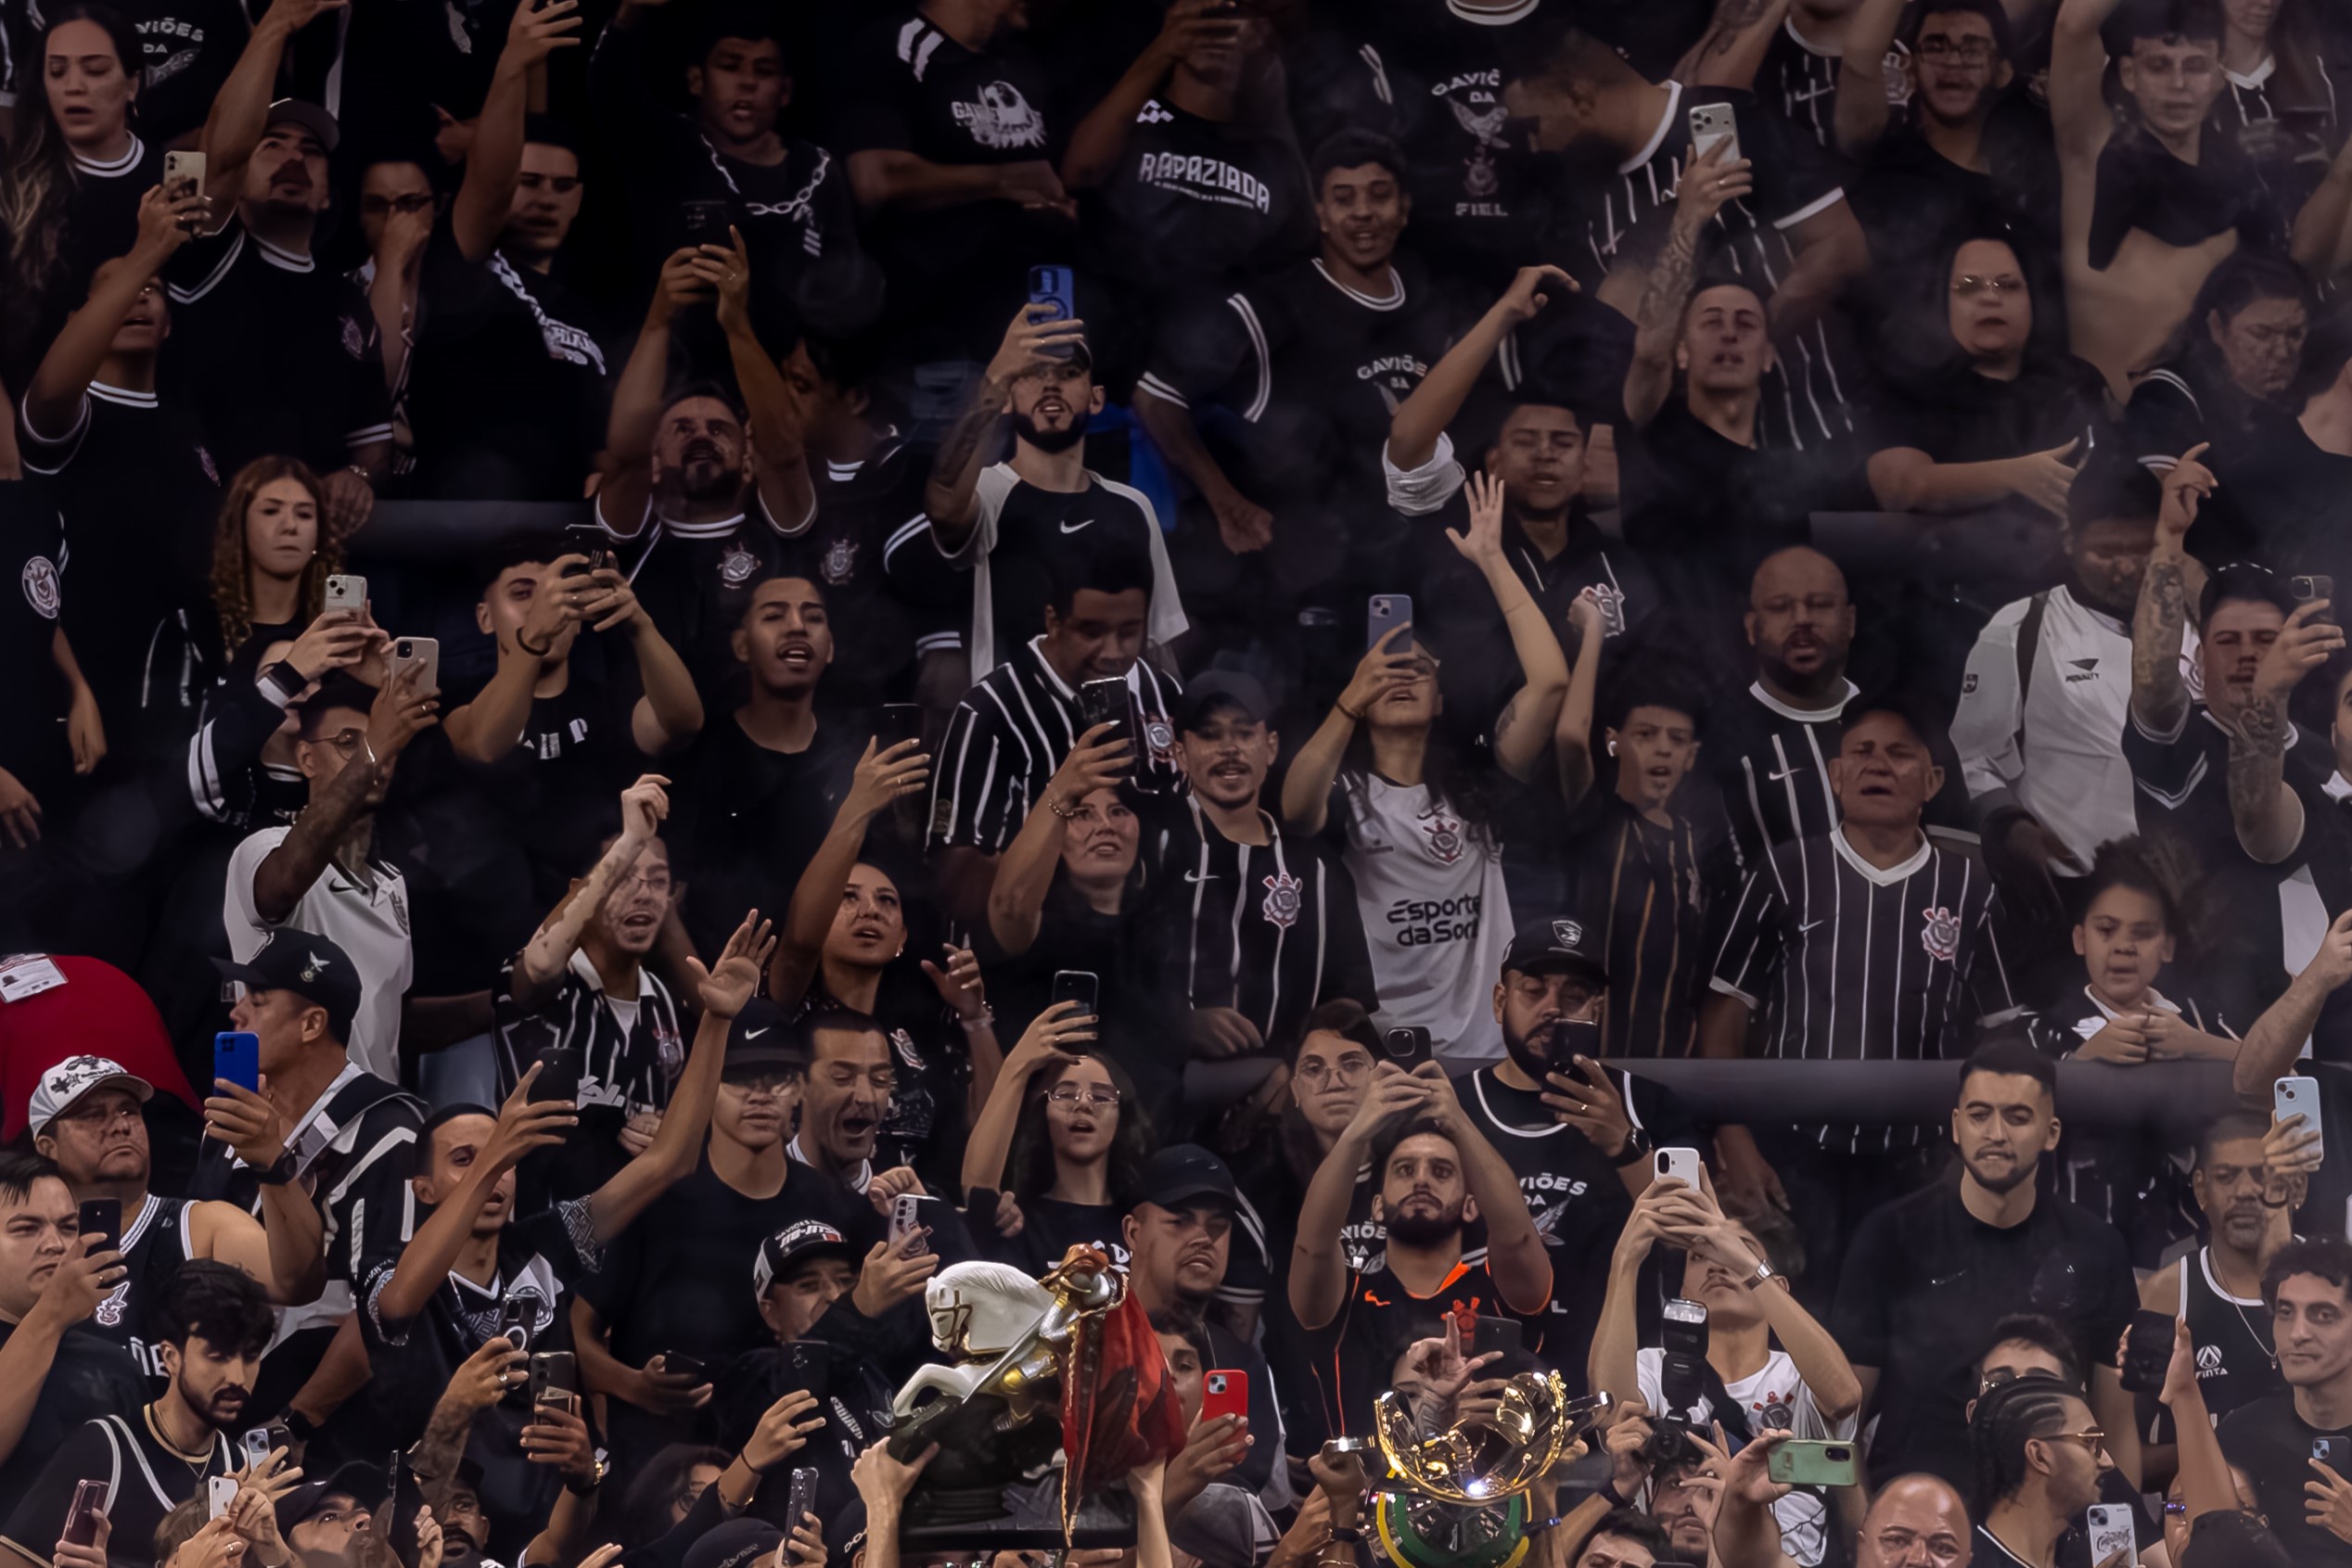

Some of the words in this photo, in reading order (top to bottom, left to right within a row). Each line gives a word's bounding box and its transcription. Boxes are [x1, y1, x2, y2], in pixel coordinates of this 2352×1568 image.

[134, 17, 204, 43] VIÕES
[142, 43, 168, 54] DA
[1431, 68, 1501, 96] GAVIÕ
[1469, 91, 1496, 103] DA
[1138, 151, 1271, 215] RAPAZIADA
[1455, 202, 1509, 217] FIEL
[1357, 354, 1428, 380] GAVIÕE
[1387, 893, 1480, 924] Esporte
[1340, 1220, 1387, 1240] VIÕE
